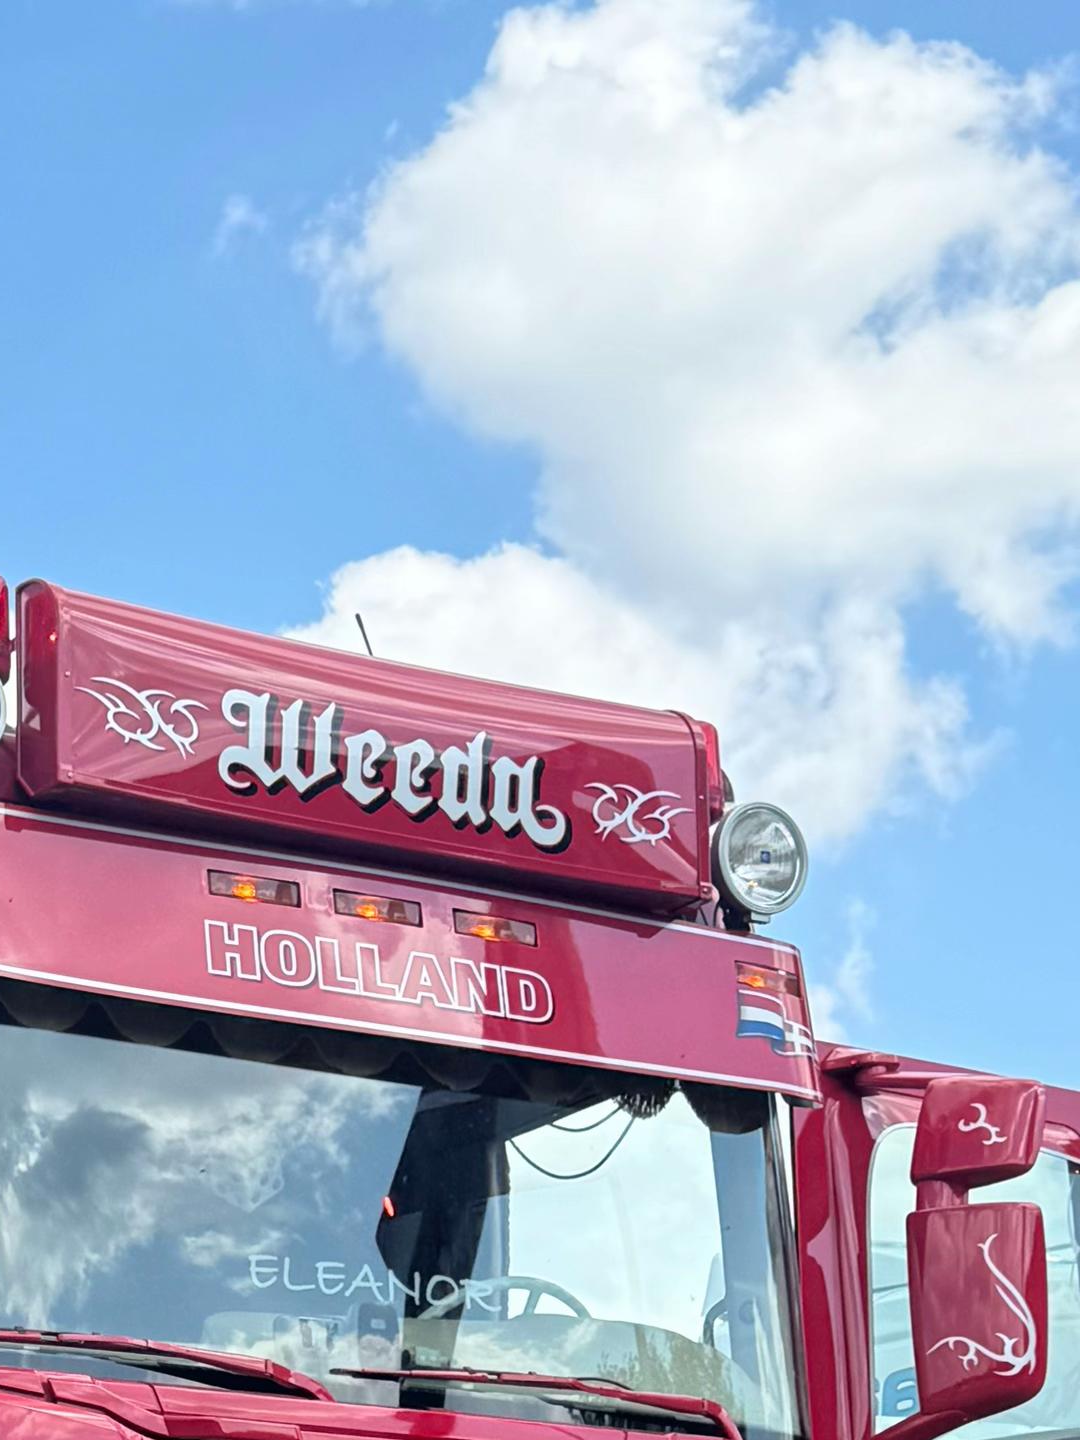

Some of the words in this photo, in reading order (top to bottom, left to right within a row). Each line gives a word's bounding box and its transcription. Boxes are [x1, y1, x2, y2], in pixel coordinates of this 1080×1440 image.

[218, 688, 571, 850] Weeda
[203, 920, 555, 1025] HOLLAND
[248, 1254, 502, 1313] ELEANOR
